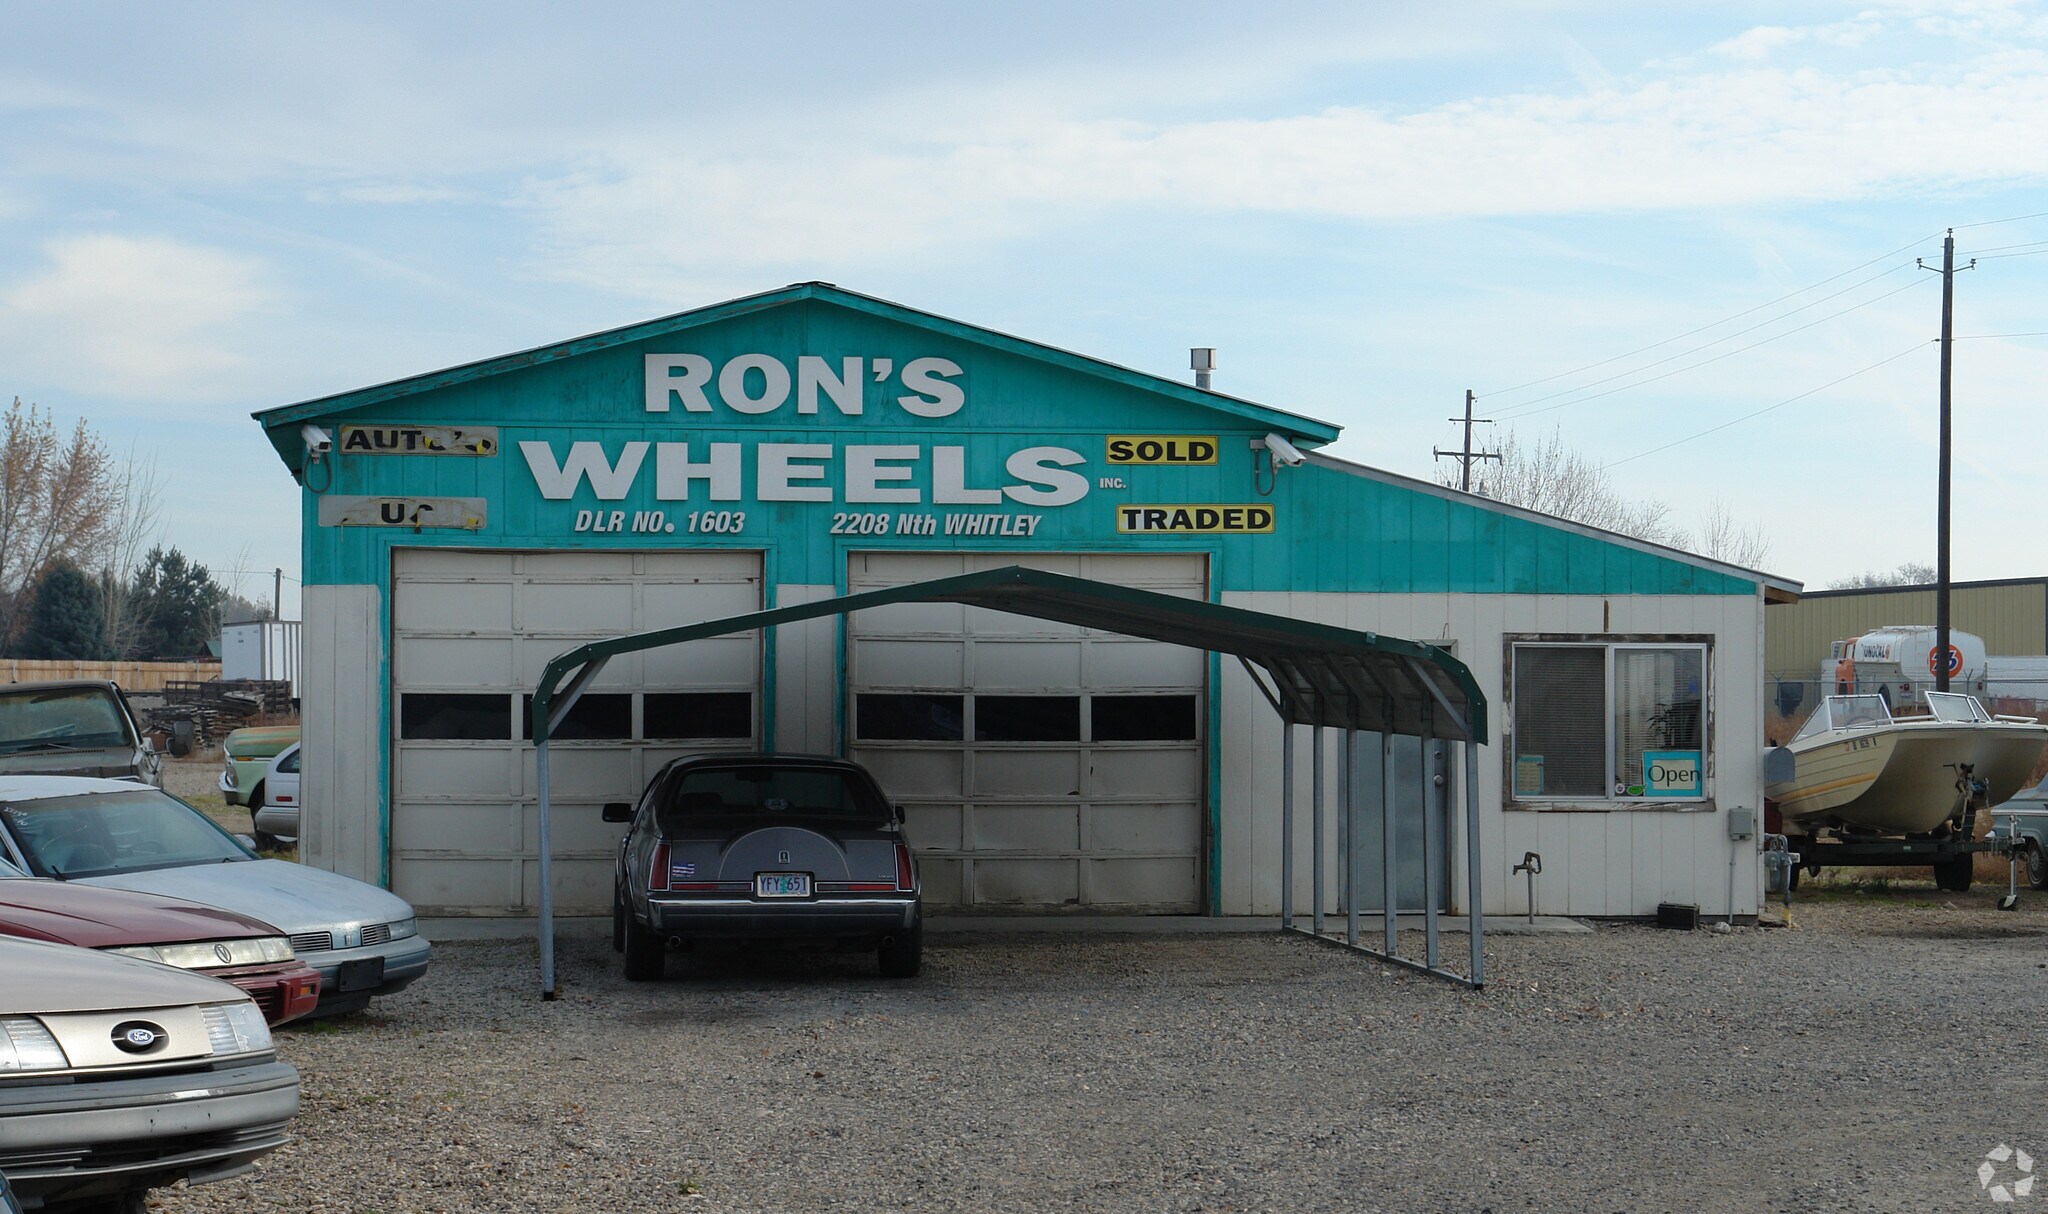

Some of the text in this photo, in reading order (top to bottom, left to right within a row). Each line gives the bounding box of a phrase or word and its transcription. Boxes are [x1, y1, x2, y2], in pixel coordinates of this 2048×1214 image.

[645, 353, 965, 418] RON'S
[1108, 440, 1214, 461] SOLD
[518, 441, 1127, 507] WHEELS INC.
[574, 510, 746, 533] DLR NO. 1603
[829, 512, 1043, 536] 2208 Nth WHITLEY
[1122, 508, 1271, 530] TRADED
[1647, 764, 1701, 787] Open
[760, 877, 806, 891] YFY 651
[133, 1031, 149, 1041] Ford
